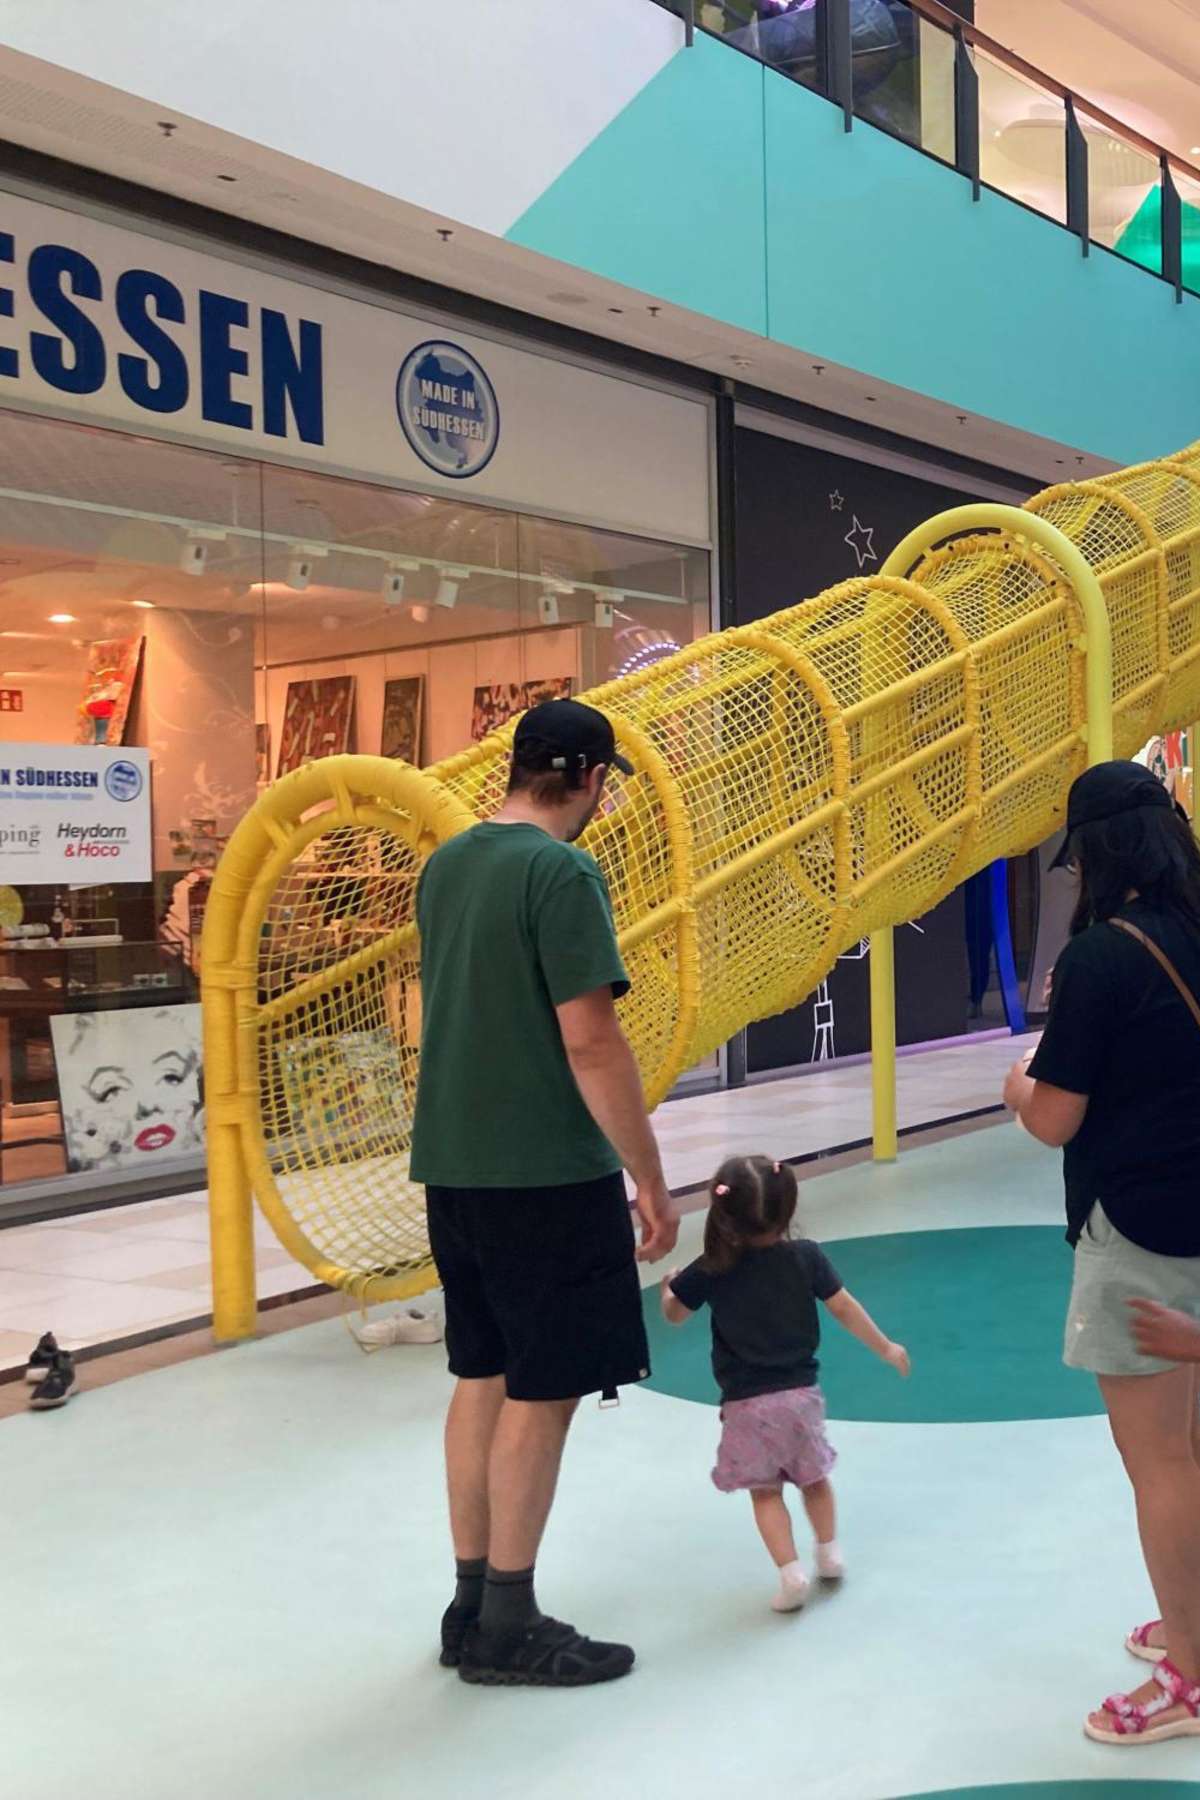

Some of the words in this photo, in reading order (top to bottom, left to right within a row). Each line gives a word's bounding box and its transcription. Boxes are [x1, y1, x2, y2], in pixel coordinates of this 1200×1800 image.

[421, 378, 459, 405] MADE
[462, 390, 476, 409] IN
[16, 766, 98, 788] SÜDHESSEN
[57, 822, 126, 841] Heydorn
